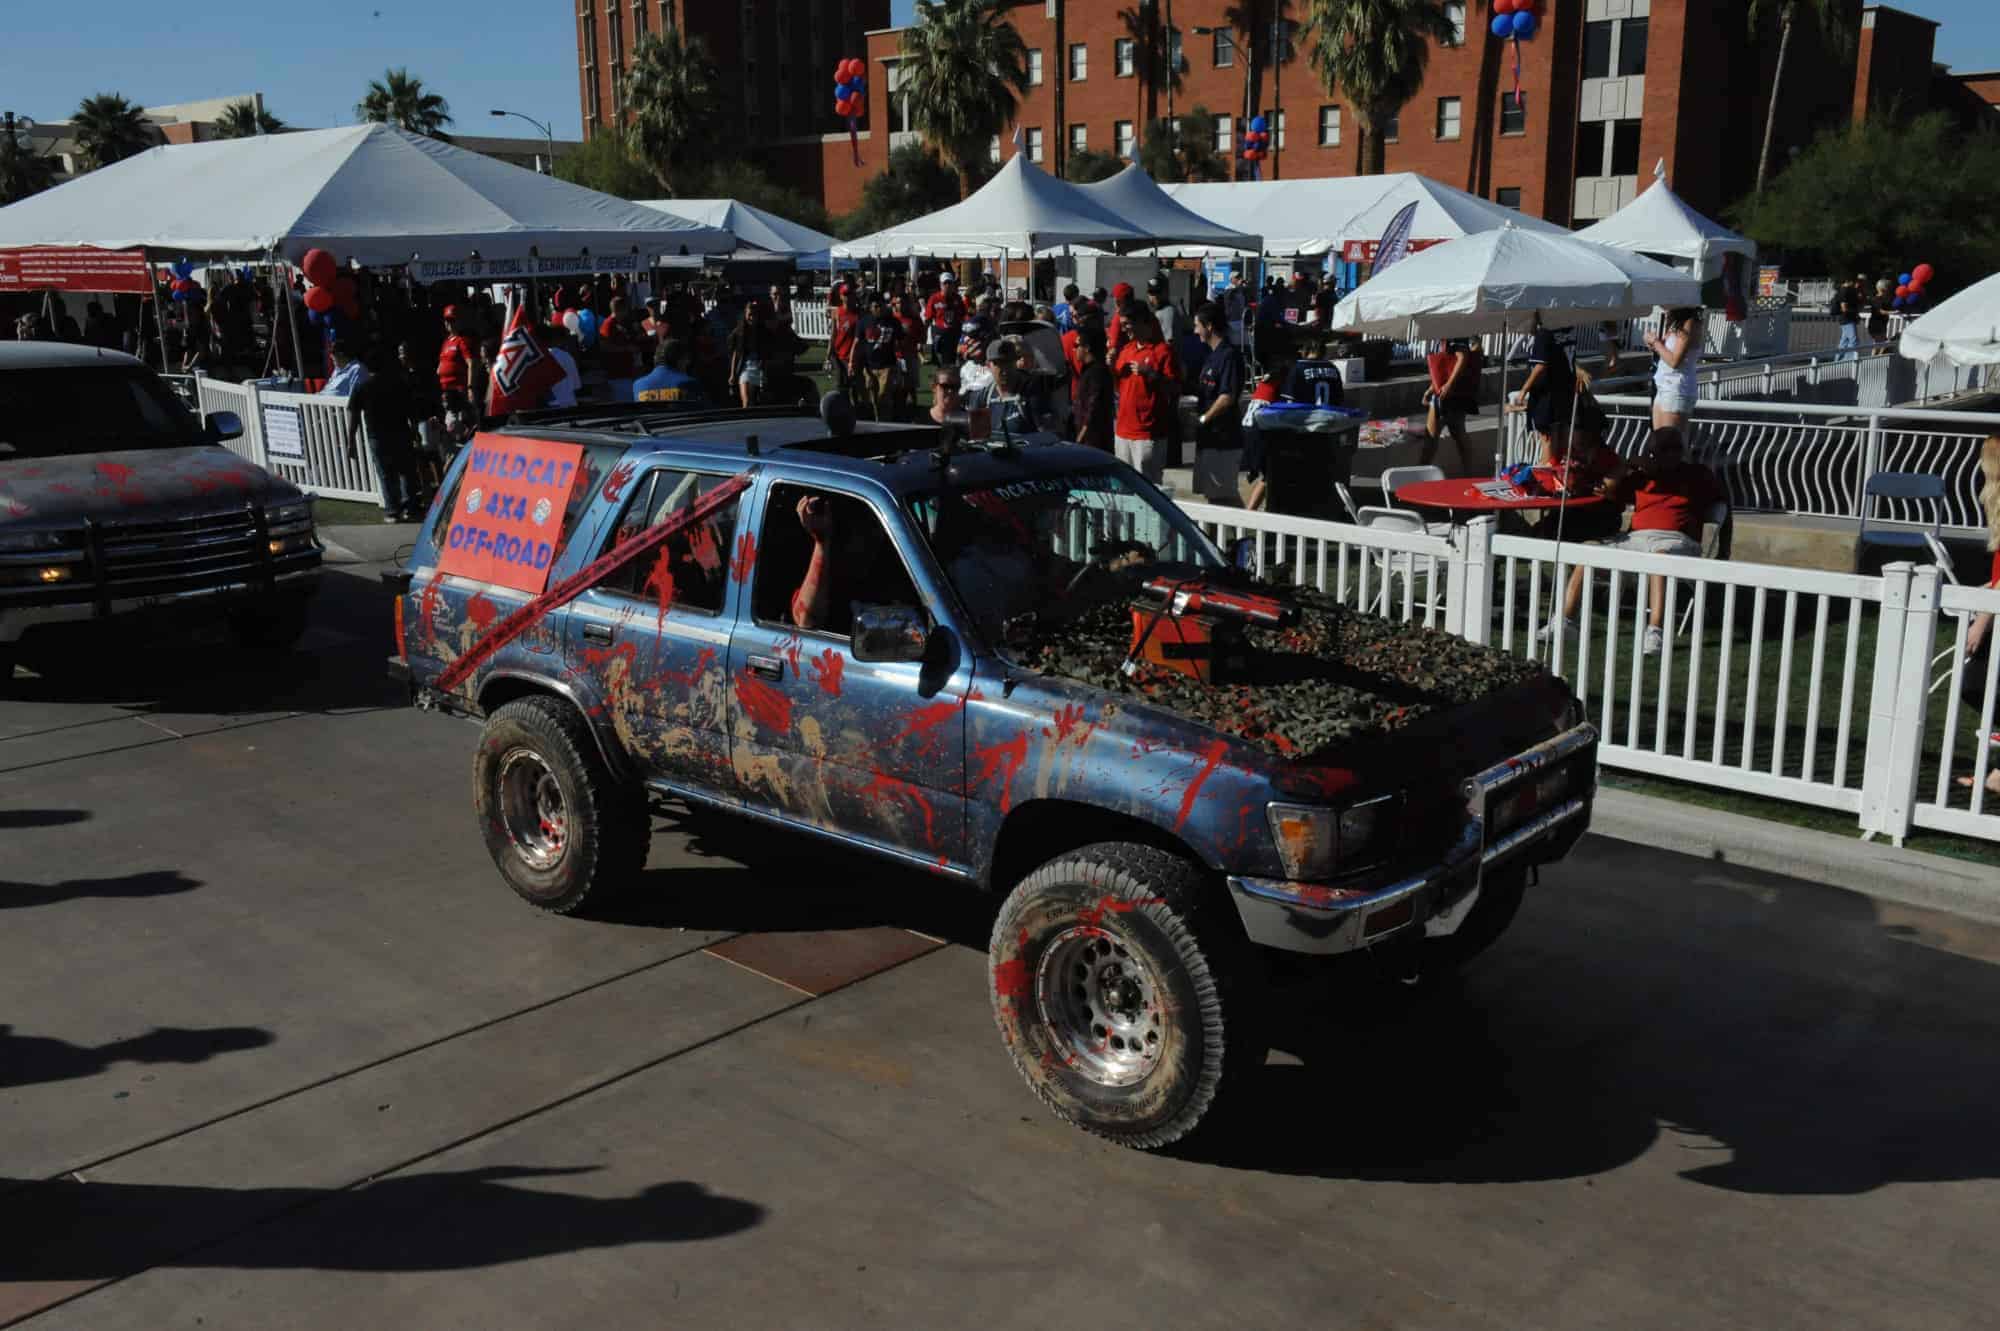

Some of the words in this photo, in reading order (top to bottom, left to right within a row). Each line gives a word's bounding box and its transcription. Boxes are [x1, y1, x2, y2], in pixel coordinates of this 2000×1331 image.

[472, 449, 574, 488] WILDCAT
[486, 492, 527, 521] 4X4
[450, 524, 552, 568] OFF-ROAD
